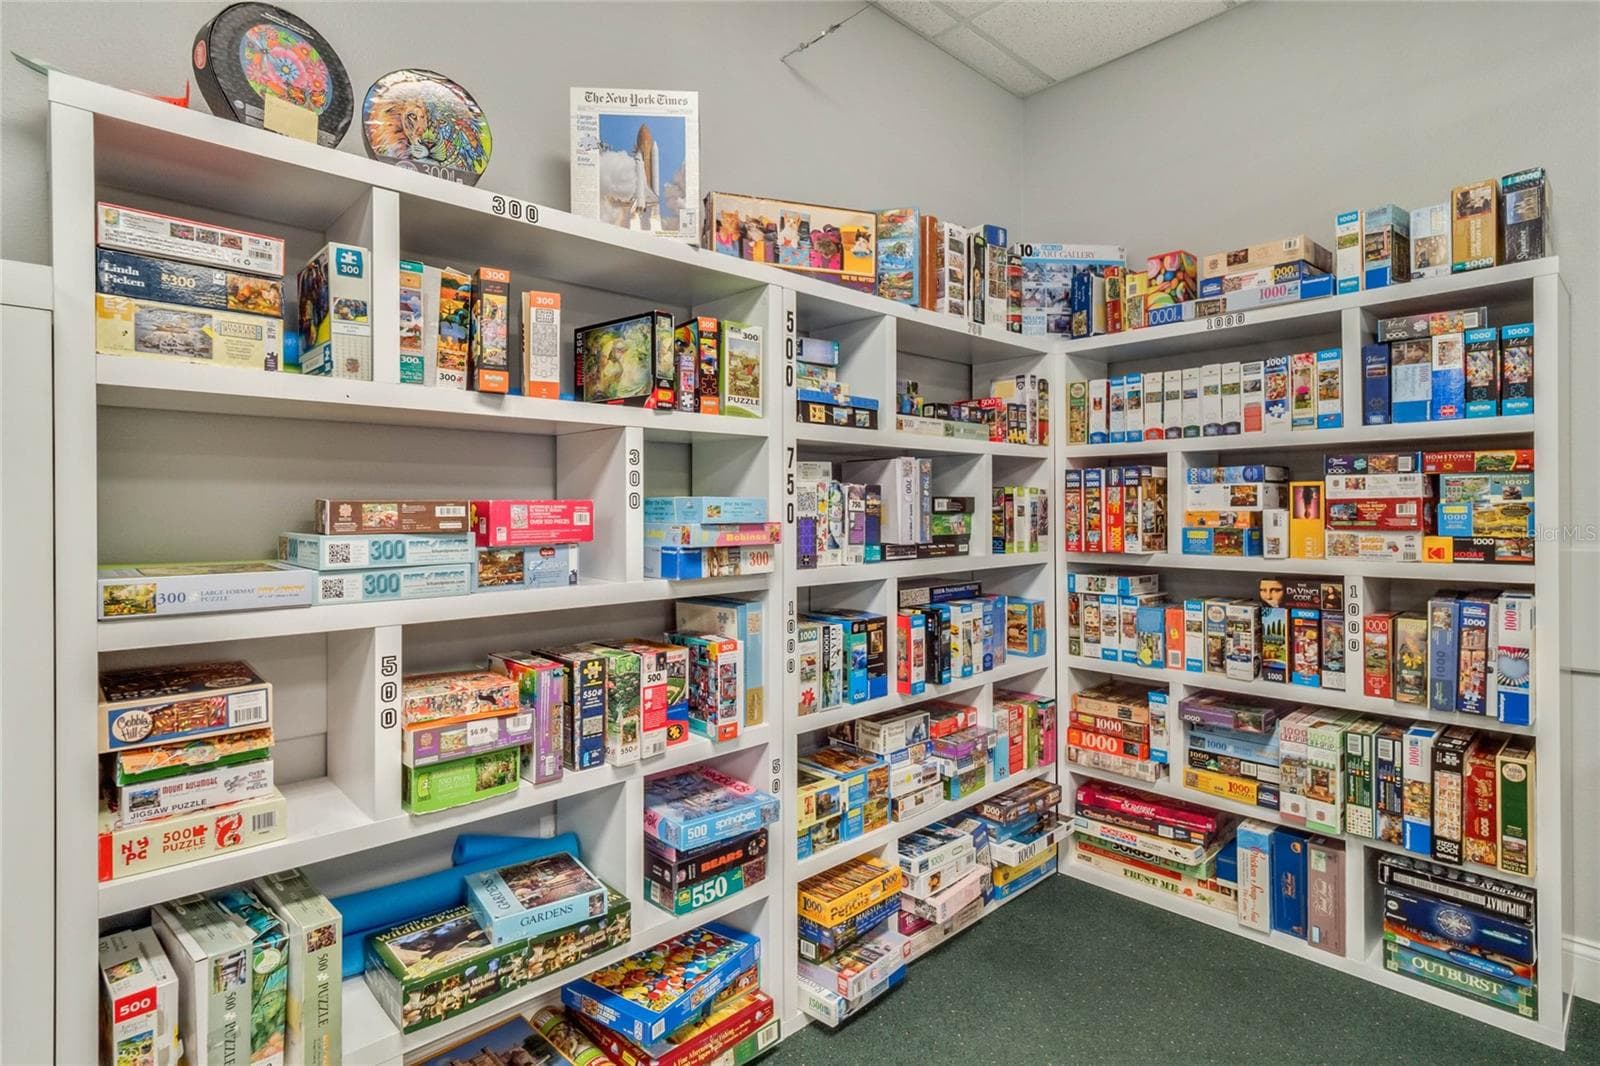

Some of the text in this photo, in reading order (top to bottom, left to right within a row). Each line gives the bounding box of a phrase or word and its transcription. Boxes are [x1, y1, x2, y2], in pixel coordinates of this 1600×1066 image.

[585, 91, 688, 107] The New York Times
[1515, 171, 1541, 184] 1000
[492, 196, 538, 224] 300
[1340, 213, 1358, 223] 1000
[1020, 244, 1032, 257] 10
[341, 265, 360, 275] 300
[1465, 257, 1494, 269] 1000
[103, 264, 140, 278] Linda
[485, 272, 506, 281] 300
[103, 274, 146, 288] Picken
[169, 273, 197, 289] 300
[1259, 284, 1287, 300] 1000
[701, 320, 715, 330] 300
[1206, 314, 1246, 331] 1000
[743, 331, 760, 342] 300
[1470, 332, 1492, 341] 1000
[1507, 327, 1530, 336] 1000
[401, 356, 420, 364] 300
[1265, 357, 1288, 367] 1000
[1321, 352, 1338, 360] 1000
[440, 372, 457, 382] 300
[728, 396, 761, 407] PUZZLE
[981, 399, 995, 407] 500
[1425, 453, 1472, 461] HOMETOWN
[628, 449, 641, 511] 300
[787, 447, 795, 525] 750
[1473, 538, 1494, 546] 1000
[371, 540, 406, 561] 300
[750, 551, 769, 567] 300
[364, 573, 400, 595] 300
[157, 592, 187, 606] 300
[1187, 602, 1201, 610] 1000
[1348, 585, 1360, 653] 1000
[1463, 617, 1486, 628] 1000
[1505, 609, 1518, 632] 1000
[800, 630, 818, 641] 1000
[721, 643, 735, 651] 300
[1436, 650, 1446, 678] 1000
[647, 672, 661, 684] 500
[1267, 672, 1283, 681] 1000
[382, 655, 398, 730] 500
[1096, 717, 1122, 733] 1000
[1184, 714, 1201, 723] 1000
[470, 727, 489, 737] $6.99
[1282, 727, 1308, 738] 1000
[1080, 732, 1118, 752] 1000
[1207, 740, 1228, 752] 1000
[620, 748, 634, 757] 550
[1190, 751, 1210, 761] 1000
[1408, 748, 1420, 767] 1000
[248, 768, 265, 777] OVER
[162, 782, 184, 796] MOUNT
[246, 782, 268, 792] PIECES
[1228, 781, 1250, 795] 1000
[130, 799, 207, 821] JIGSAW PUZZLE
[983, 806, 1000, 816] 1000
[688, 809, 758, 840] 500 springbok
[163, 828, 192, 845] 500
[163, 837, 207, 854] PUZZLE
[1017, 843, 1036, 864] 1000
[700, 849, 744, 873] BEARS
[881, 873, 898, 891] 1000
[1123, 867, 1180, 895] TRUST ME
[479, 878, 512, 910] GARDENS
[693, 876, 728, 908] 550
[802, 896, 822, 913] 1000
[830, 892, 869, 921] Pencils
[1486, 895, 1527, 918] DIPLOMAT
[520, 904, 574, 928] GARDENS
[375, 921, 434, 942] Wildlife
[1412, 955, 1503, 995] OUTBURST
[318, 953, 329, 1028] 500 PUZZLE
[119, 997, 152, 1016] 500
[225, 990, 238, 1011] 500
